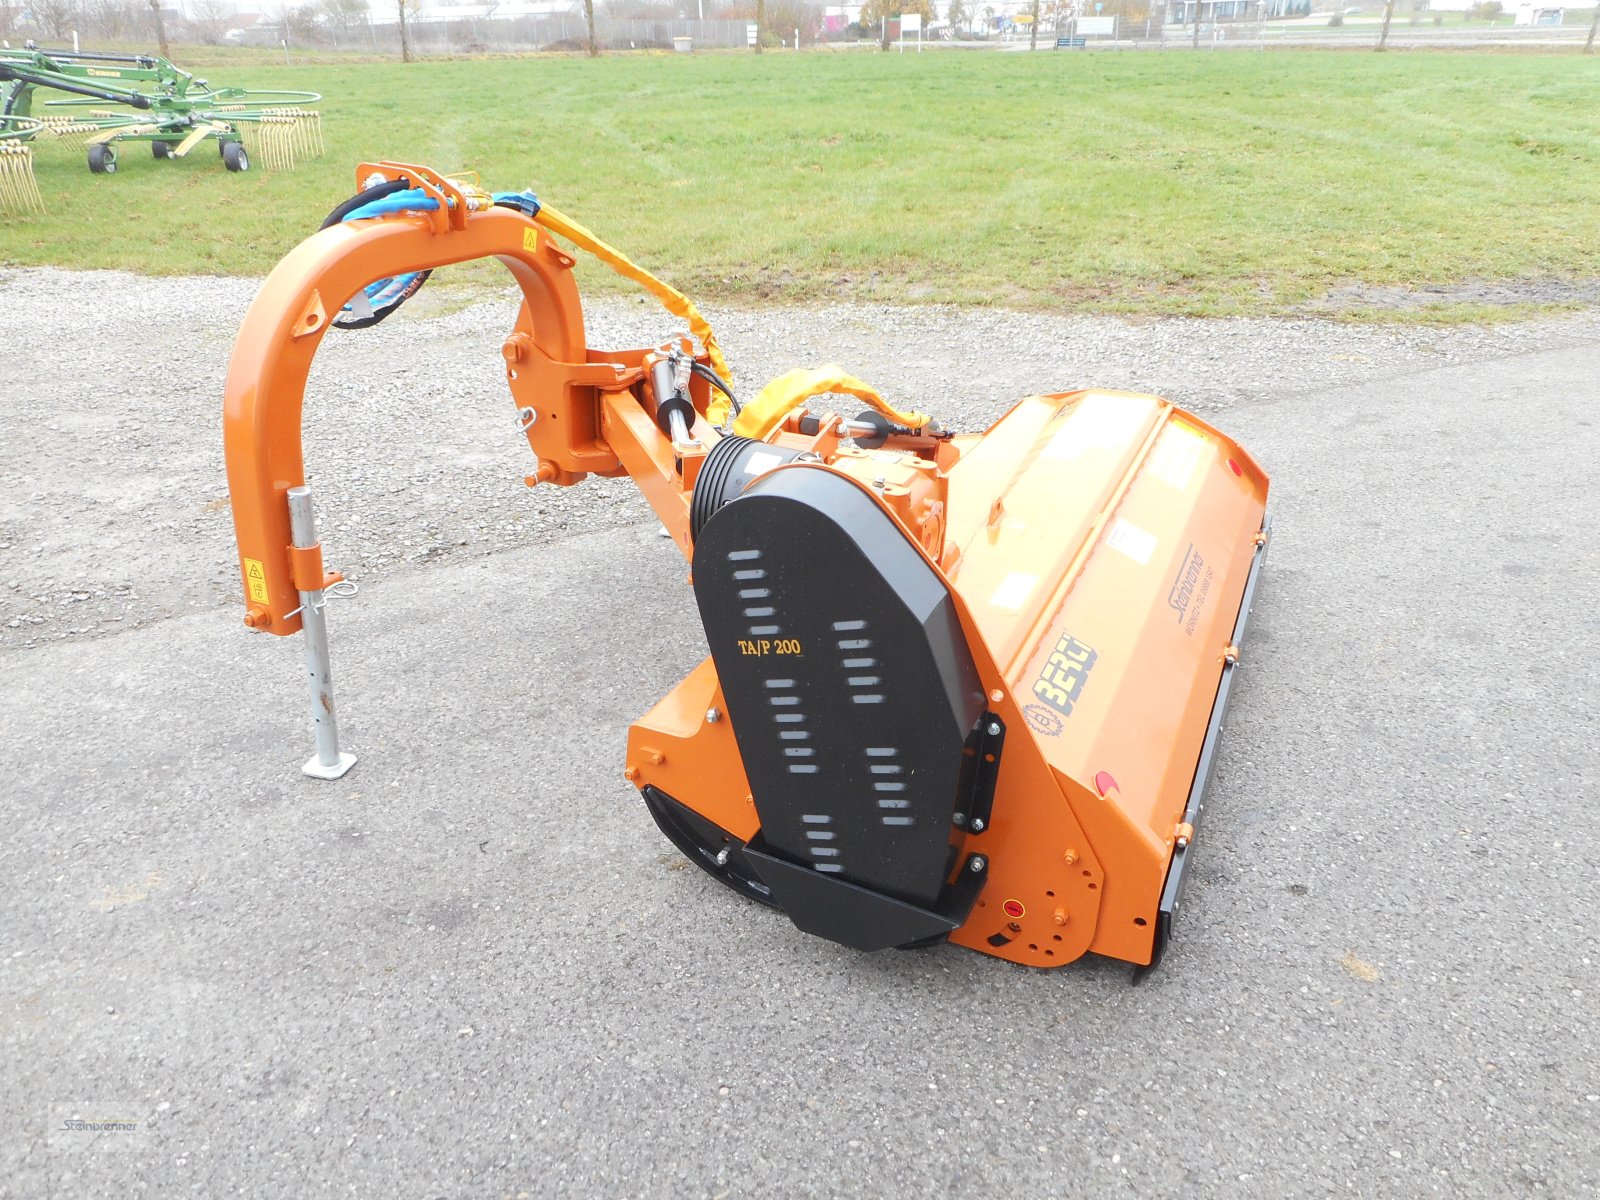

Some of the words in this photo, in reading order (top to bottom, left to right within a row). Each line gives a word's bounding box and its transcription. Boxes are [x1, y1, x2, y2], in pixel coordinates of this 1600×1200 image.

[1168, 549, 1204, 624] Steinbrenner
[738, 640, 771, 656] TA/P
[774, 639, 801, 654] 200
